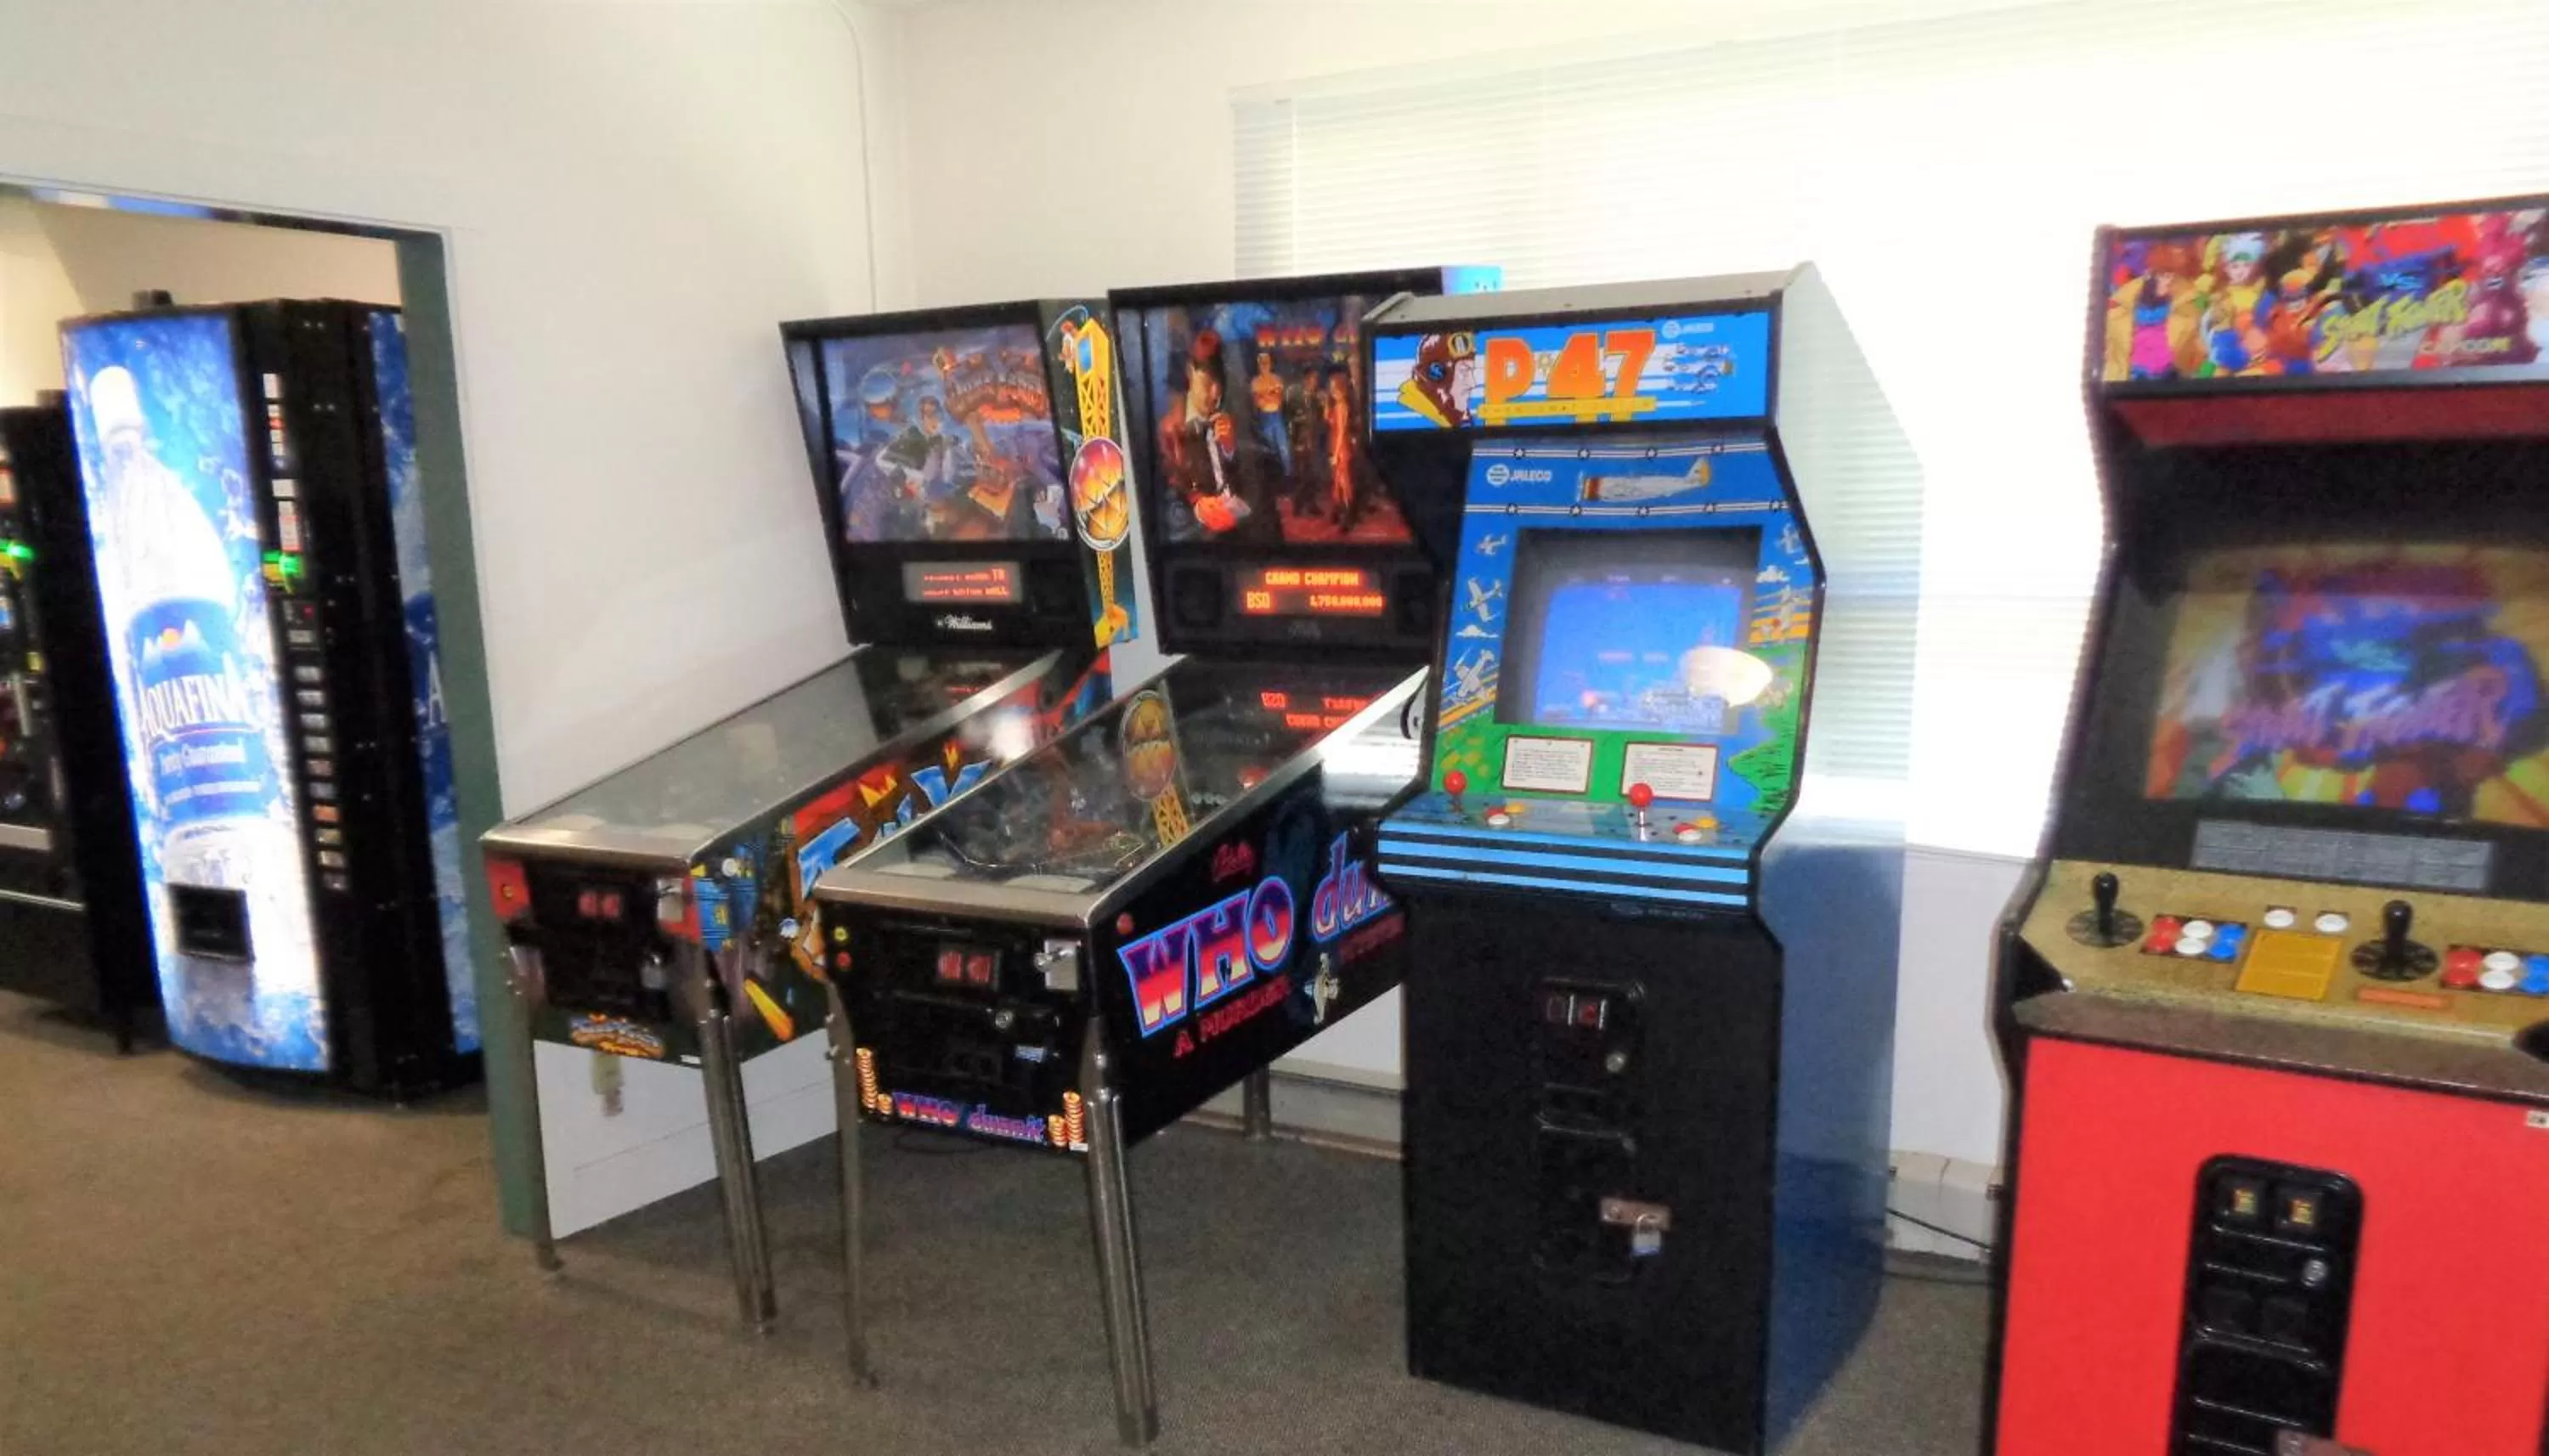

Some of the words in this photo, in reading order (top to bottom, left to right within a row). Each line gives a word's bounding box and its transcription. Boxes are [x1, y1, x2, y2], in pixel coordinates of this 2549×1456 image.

[1510, 470, 1551, 483] JALECO
[1265, 571, 1301, 585] GRAND
[1304, 571, 1359, 585] CHAMPION
[136, 650, 253, 739] AQUAFINA
[1116, 875, 1294, 1038] WHO
[892, 1092, 961, 1128] WHO
